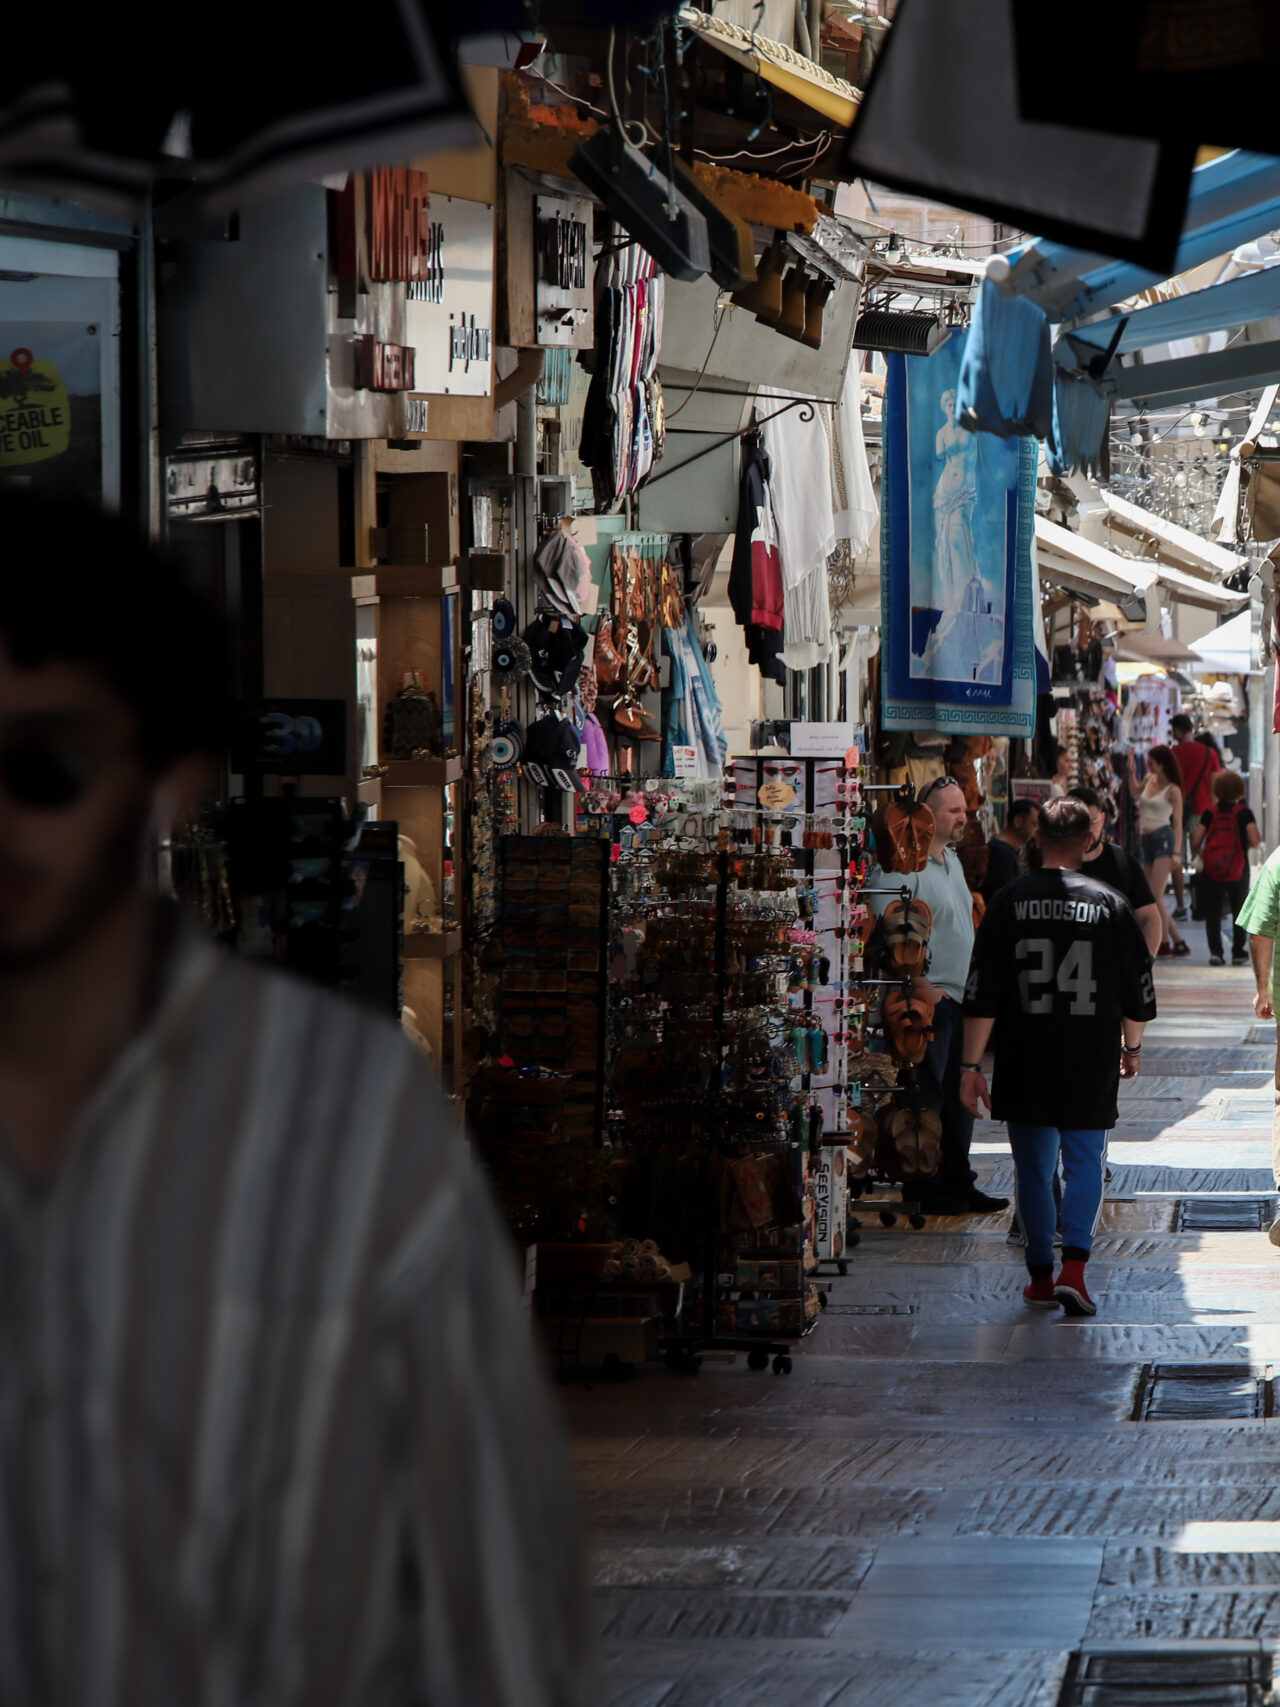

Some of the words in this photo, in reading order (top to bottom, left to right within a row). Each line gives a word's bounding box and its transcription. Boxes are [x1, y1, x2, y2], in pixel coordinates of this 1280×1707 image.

[19, 430, 49, 450] OIL
[257, 712, 323, 756] 3D
[1014, 899, 1101, 925] WOODSON
[1014, 938, 1097, 1016] 24
